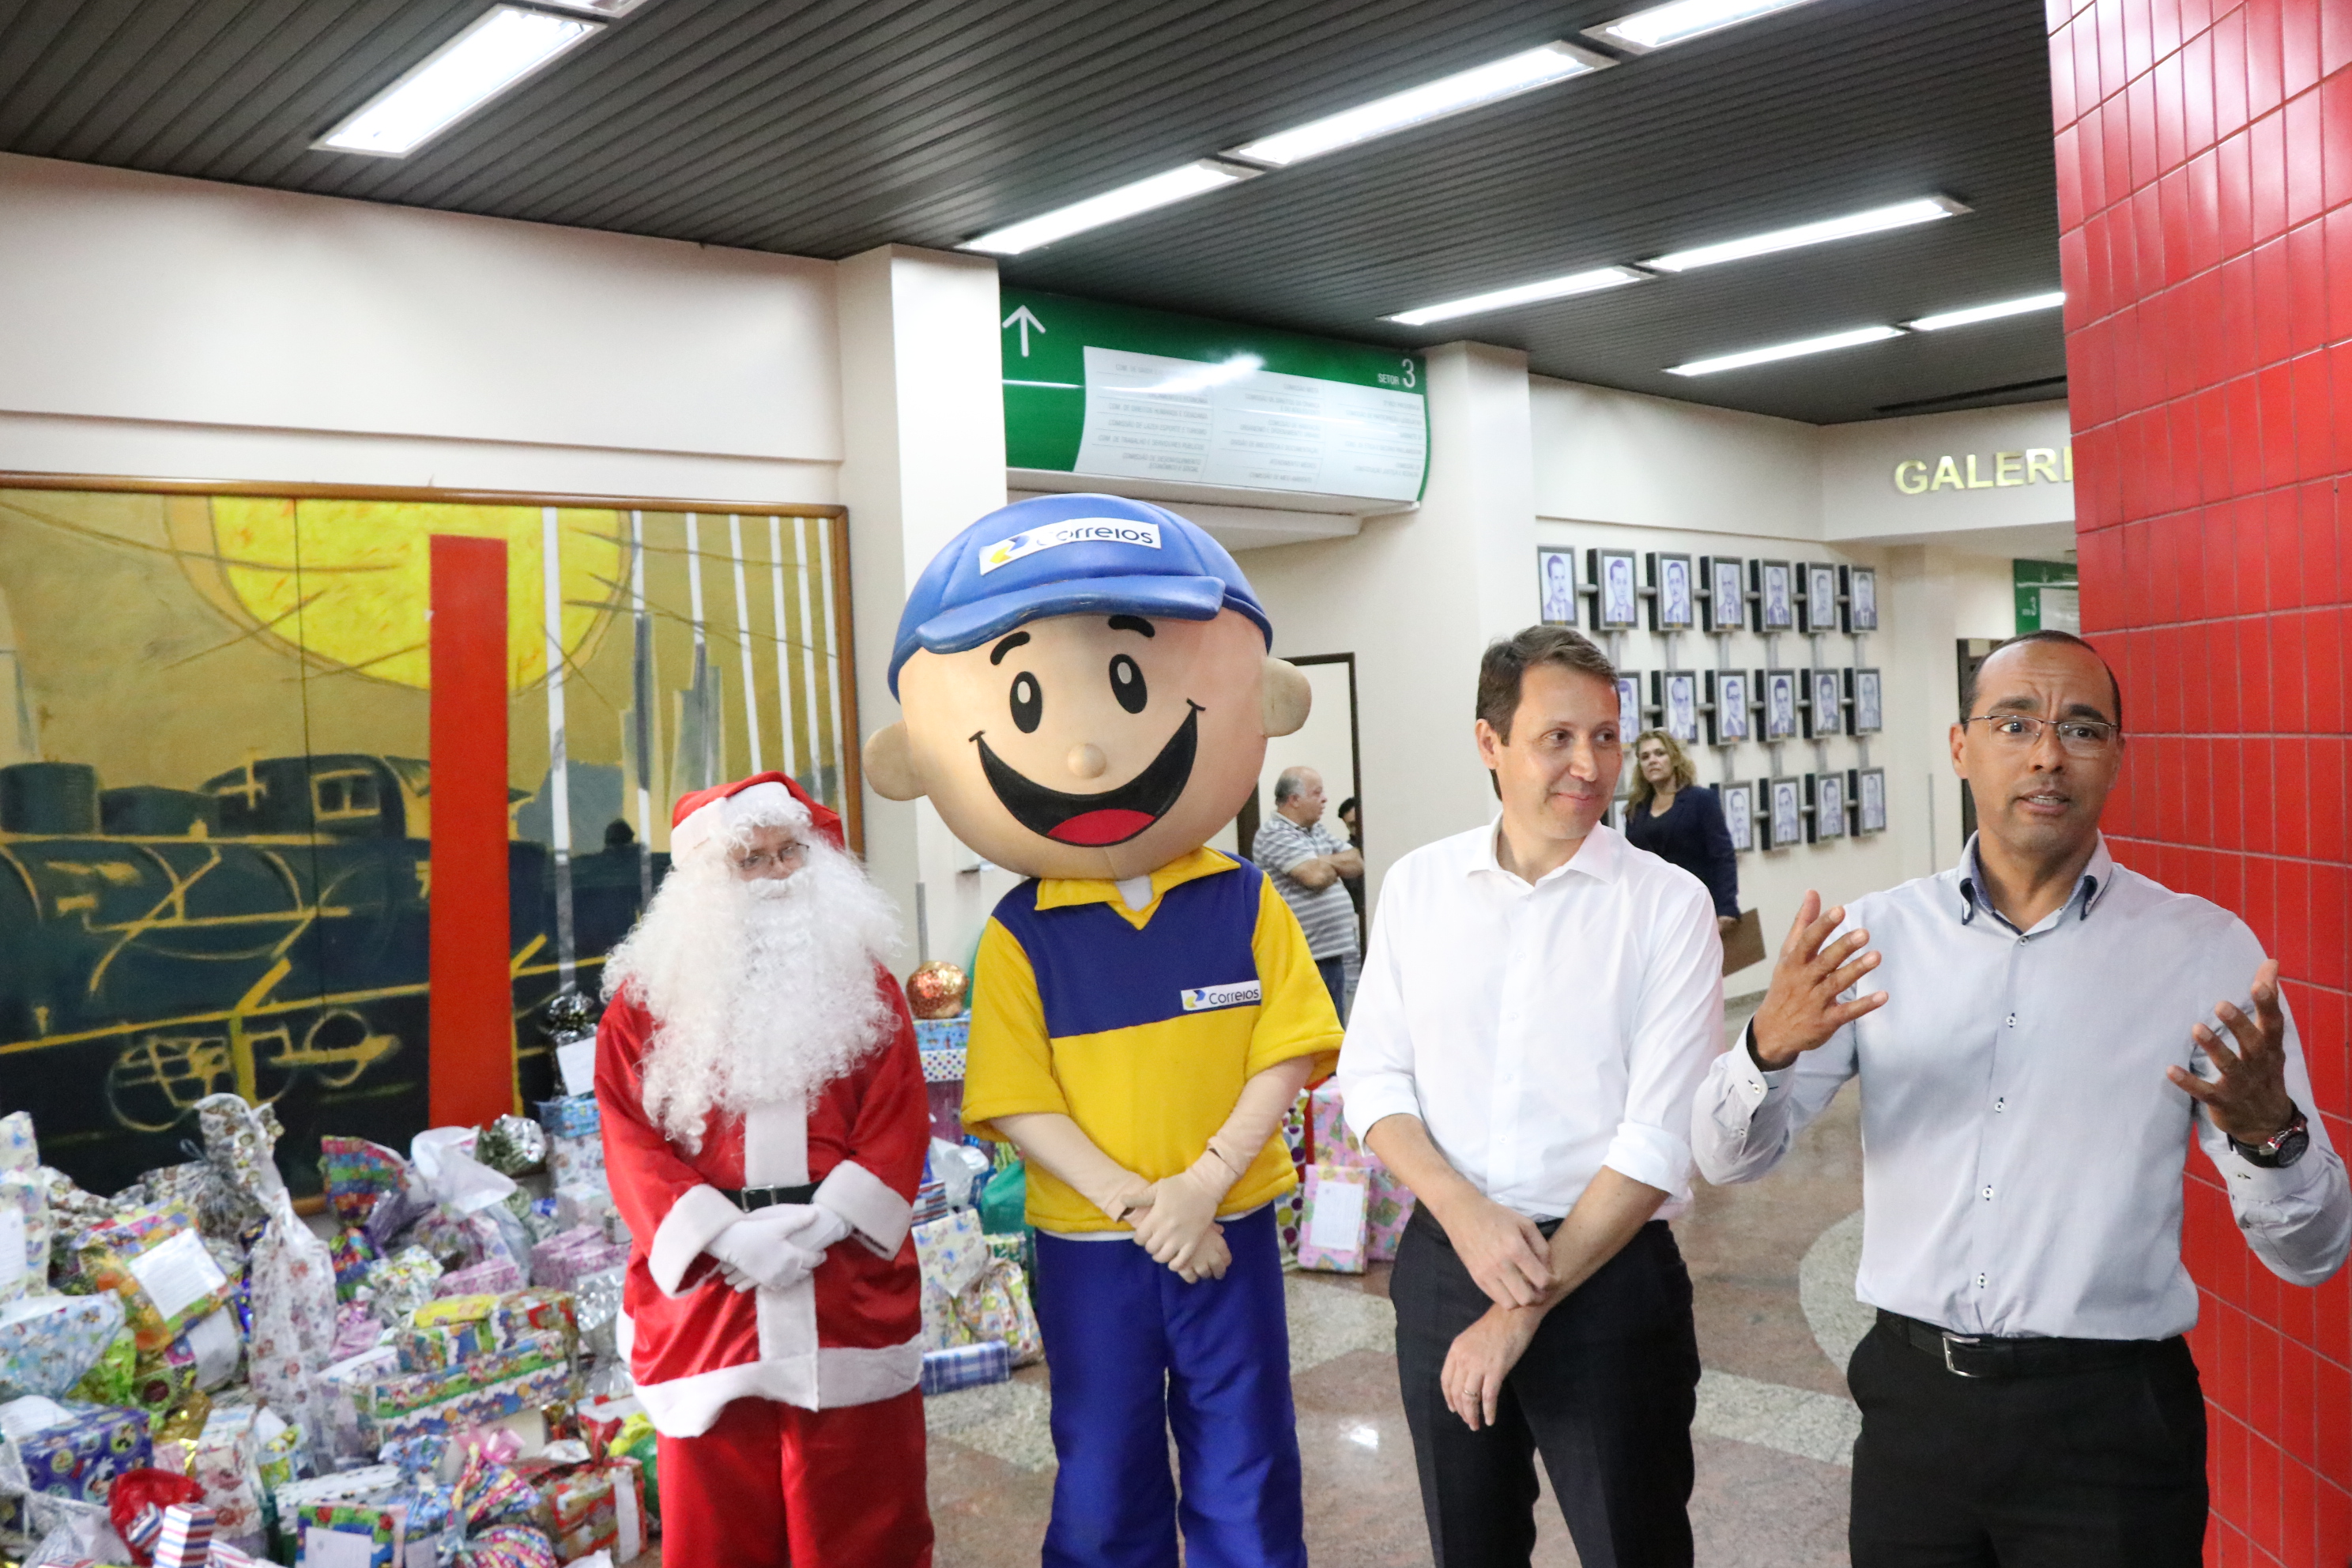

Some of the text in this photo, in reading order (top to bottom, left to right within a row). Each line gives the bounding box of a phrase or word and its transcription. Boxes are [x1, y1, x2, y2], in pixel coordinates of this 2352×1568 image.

[1378, 358, 1415, 388] SETOR 3
[1895, 447, 2074, 495] GALERI
[1209, 989, 1259, 1004] Correios
